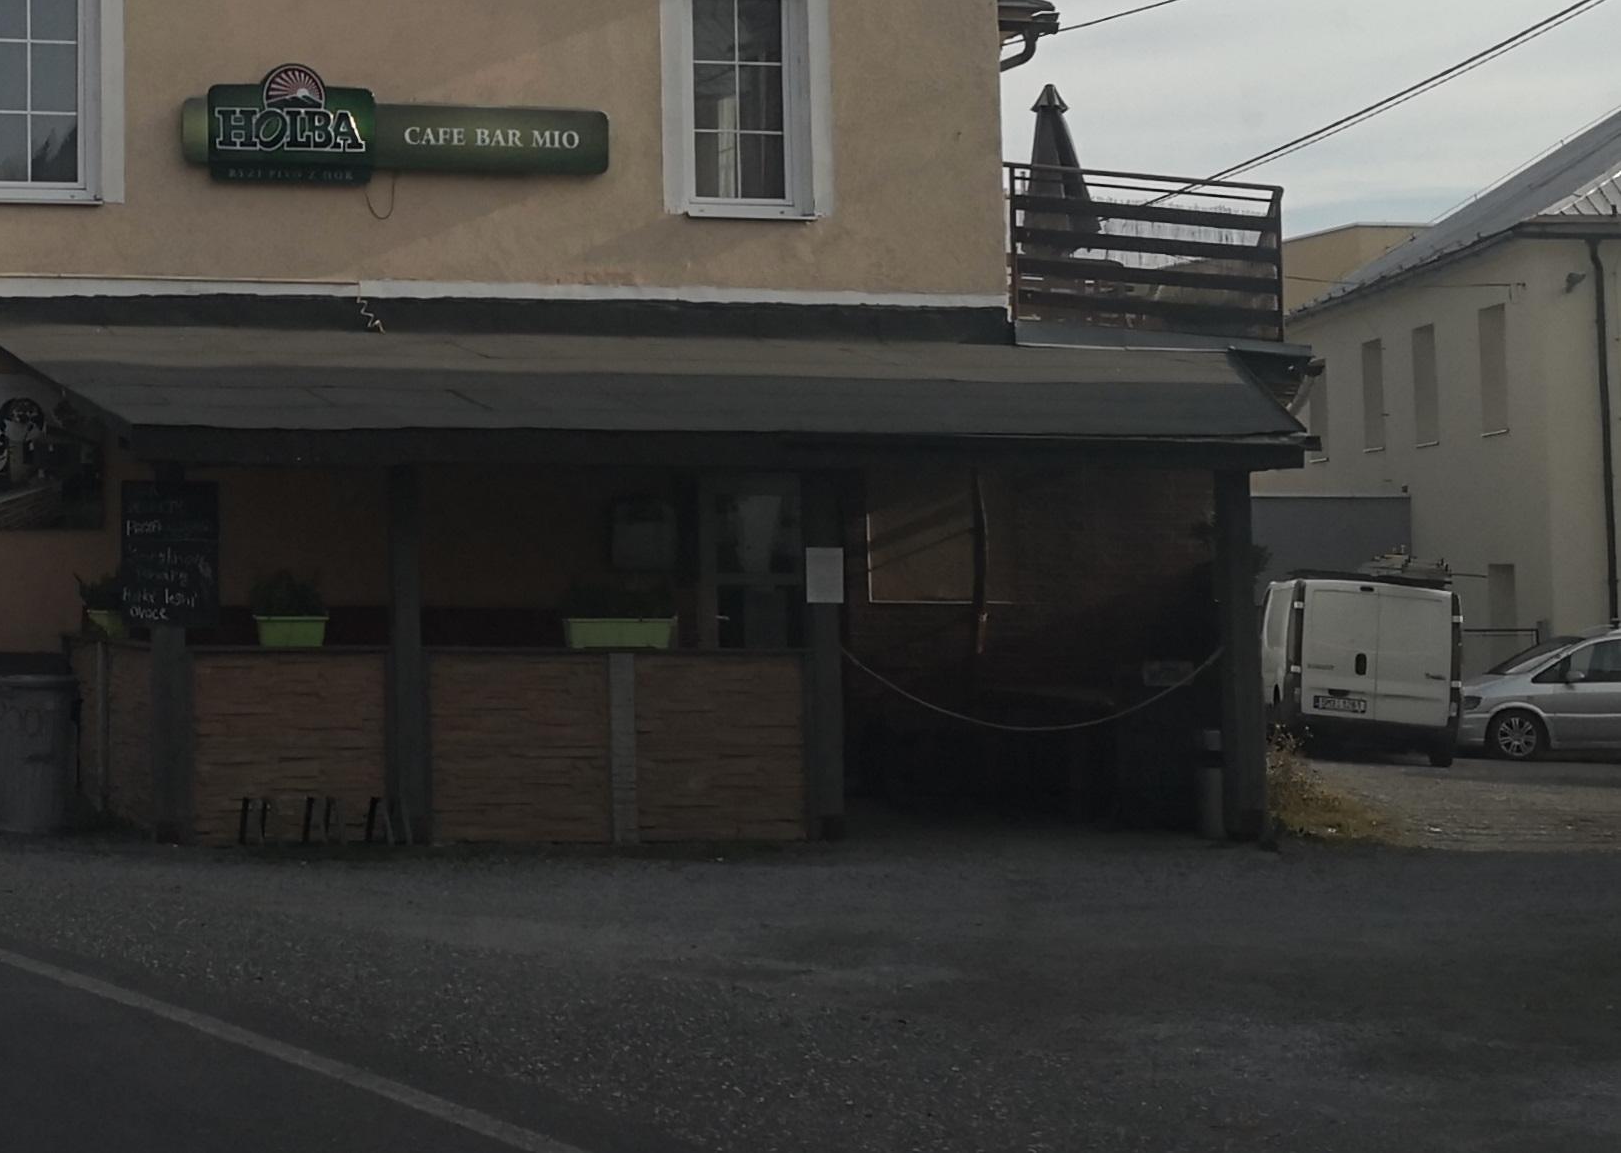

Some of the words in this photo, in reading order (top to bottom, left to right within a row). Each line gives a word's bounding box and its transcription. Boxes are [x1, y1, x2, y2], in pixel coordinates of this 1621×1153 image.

[215, 107, 366, 153] HOLBA
[403, 126, 466, 147] CAFE
[475, 128, 524, 148] BAR
[532, 130, 581, 150] MIO
